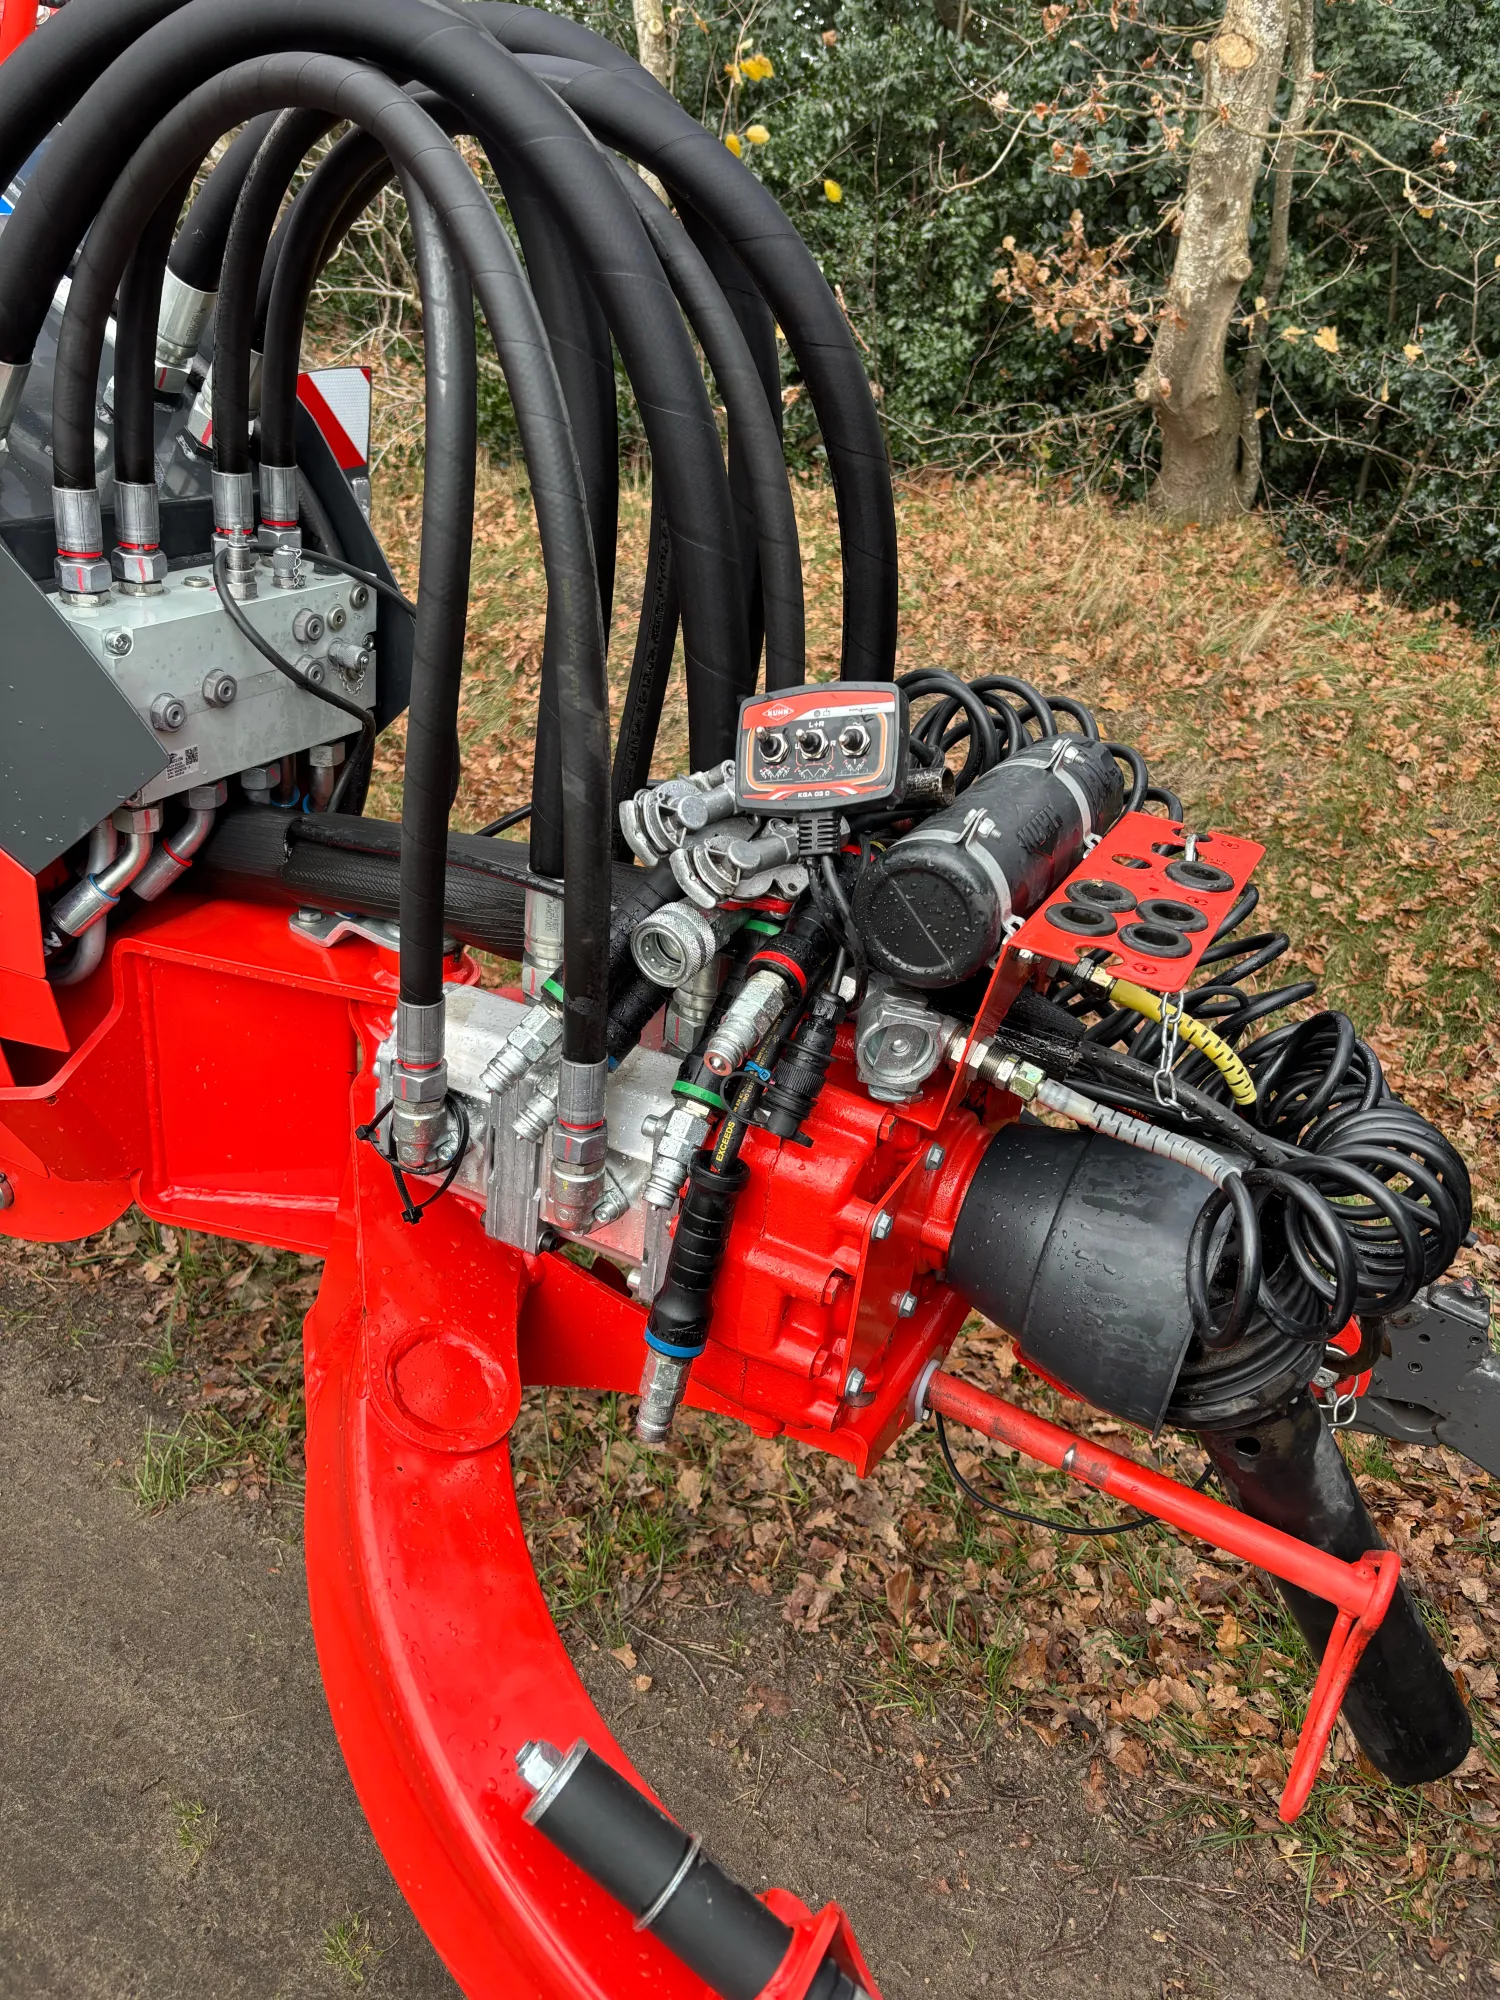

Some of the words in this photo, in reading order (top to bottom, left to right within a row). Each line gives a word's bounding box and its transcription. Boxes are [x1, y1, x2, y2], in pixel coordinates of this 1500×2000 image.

[767, 708, 789, 717] KUHN
[808, 720, 825, 728] L+R
[1016, 804, 1062, 854] KUHN
[715, 1120, 736, 1162] EXCEEDS
